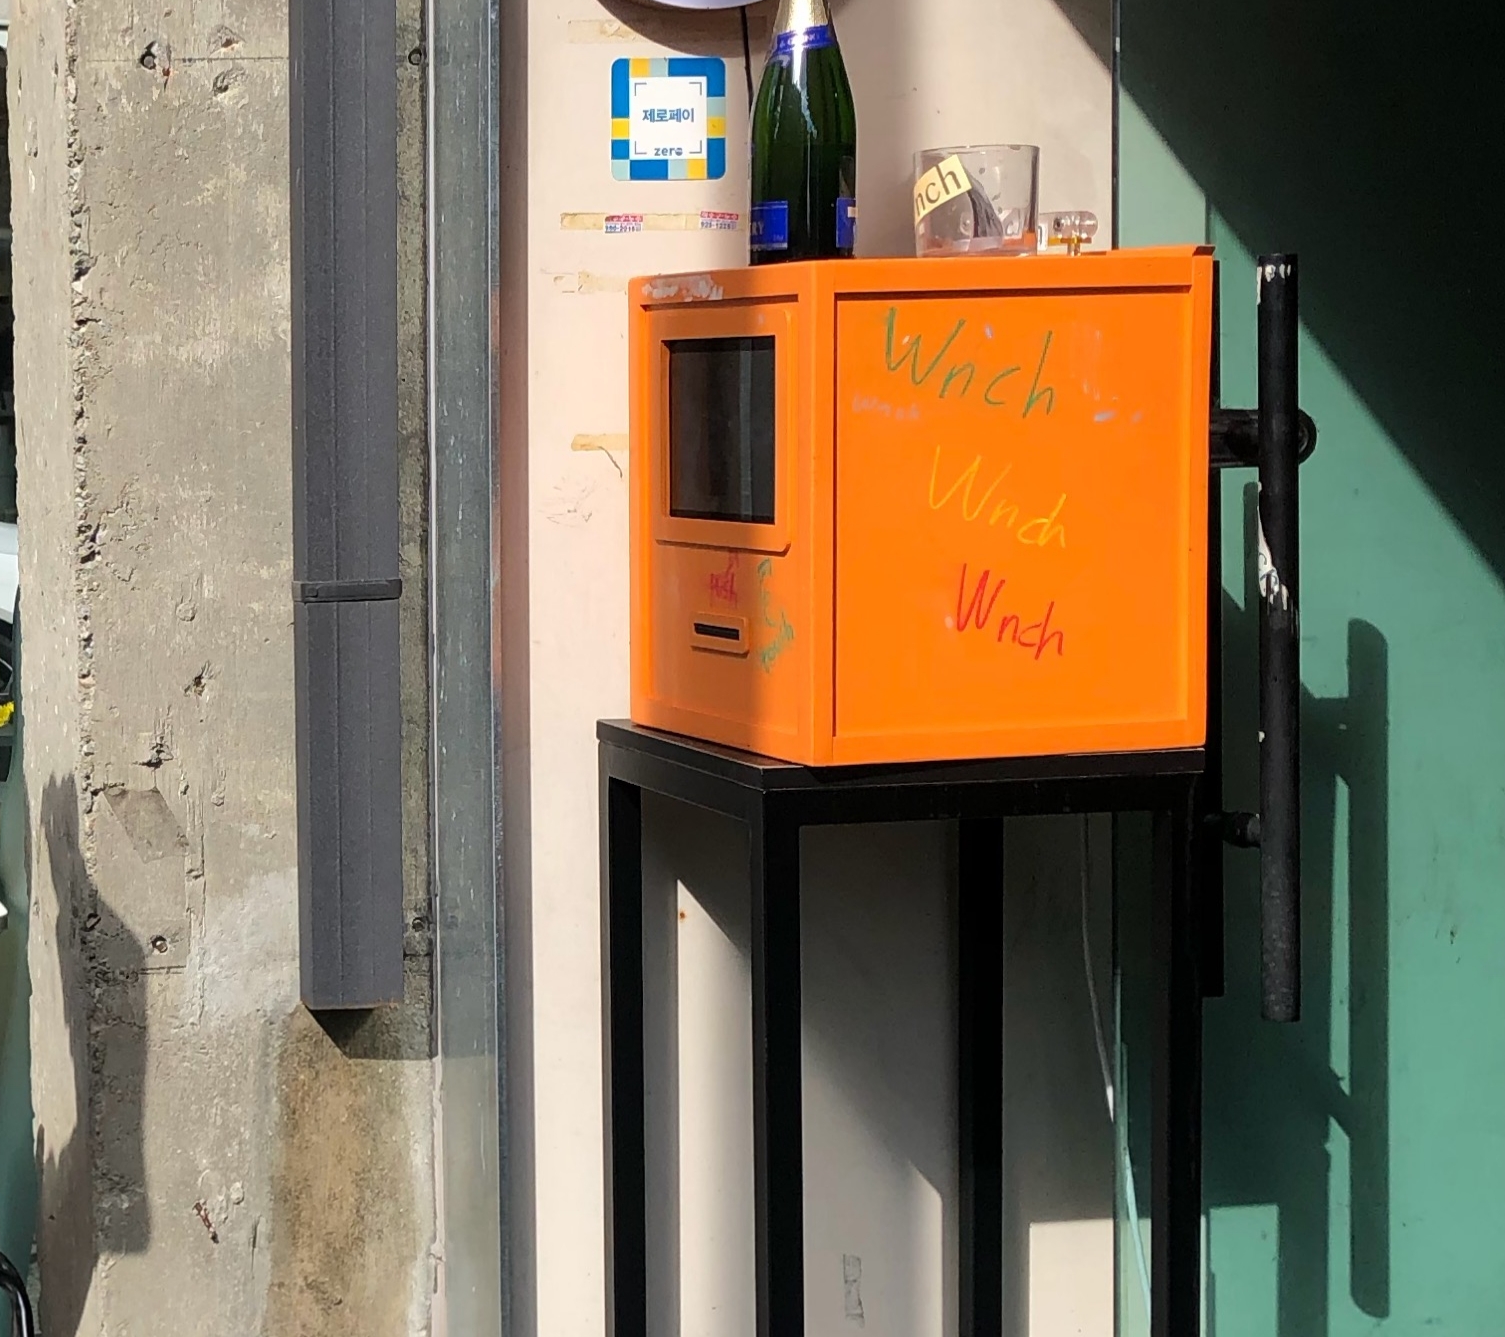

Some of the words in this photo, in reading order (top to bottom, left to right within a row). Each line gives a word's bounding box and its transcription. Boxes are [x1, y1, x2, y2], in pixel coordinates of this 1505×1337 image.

[642, 108, 695, 123] 제로페이
[653, 147, 684, 157] zero
[885, 306, 1055, 419] Wnch
[953, 562, 1064, 660] Wnch
